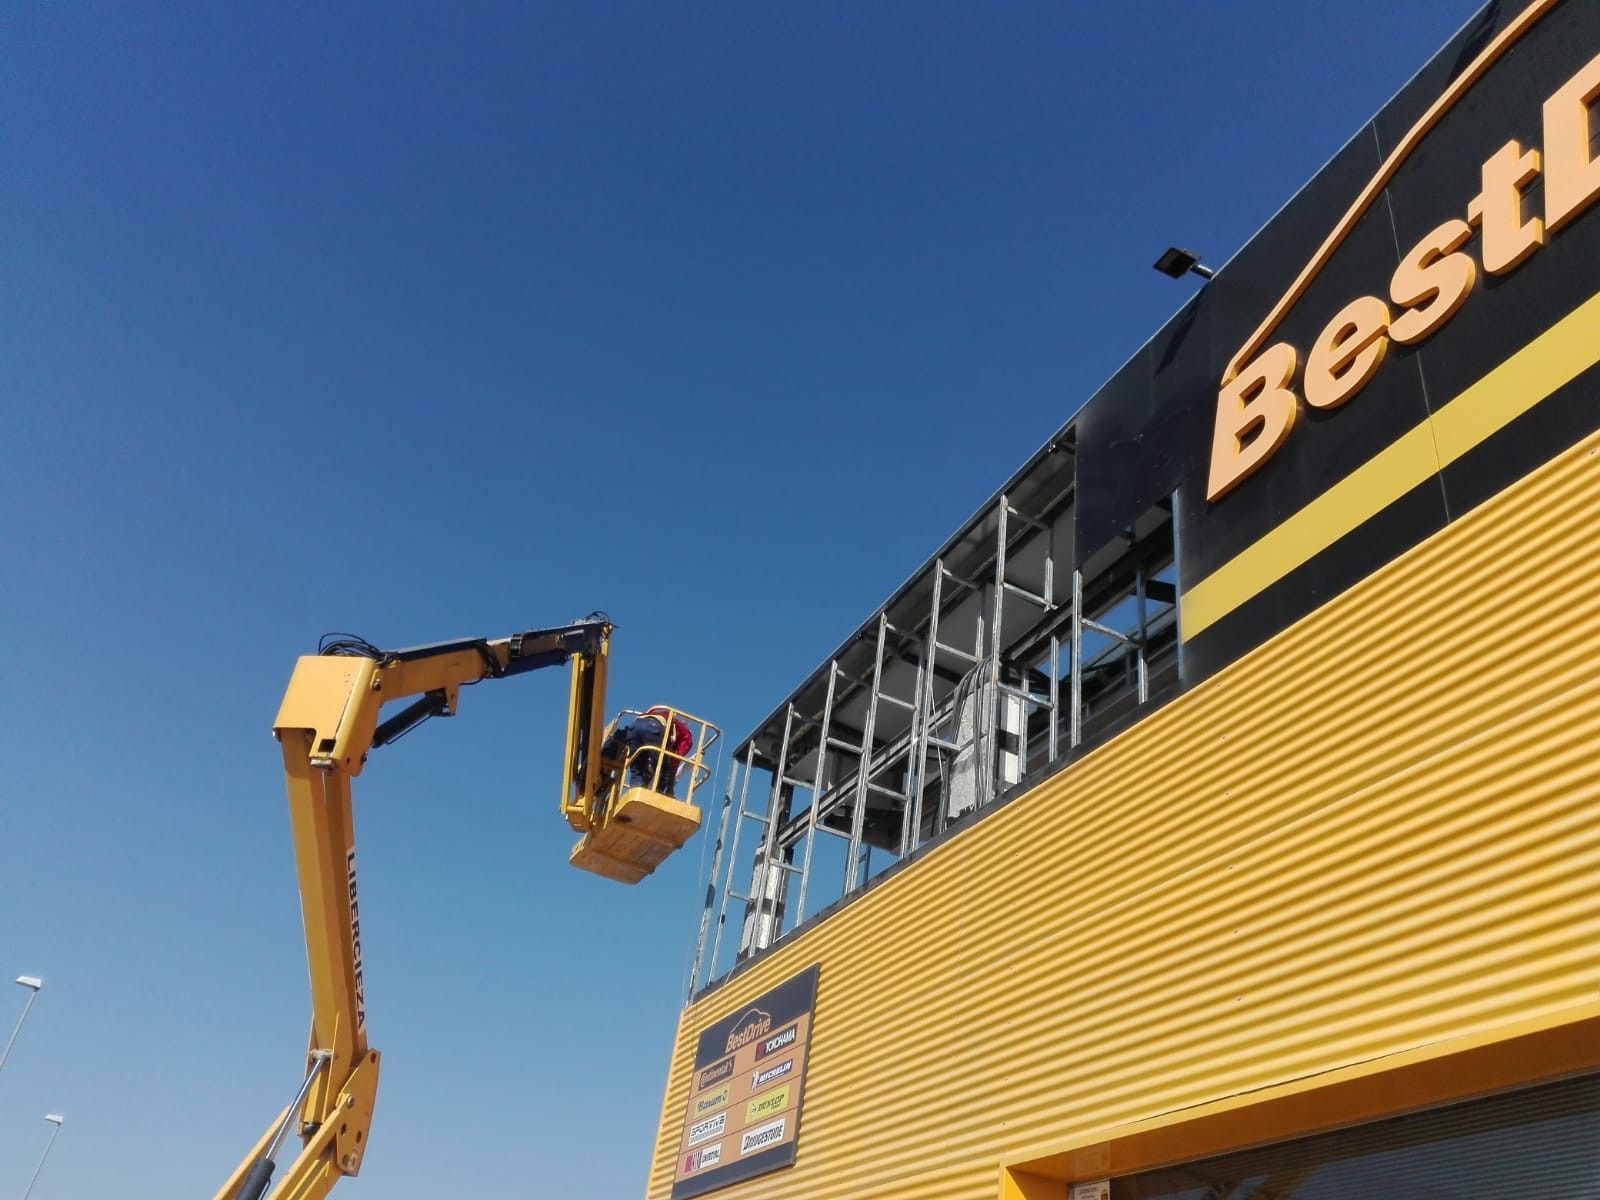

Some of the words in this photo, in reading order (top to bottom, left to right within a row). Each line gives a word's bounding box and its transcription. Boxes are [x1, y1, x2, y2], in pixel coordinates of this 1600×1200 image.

[347, 852, 365, 1029] LIBERCIEZA
[725, 1018, 771, 1053] BestDrive
[766, 1028, 795, 1053] YOKOHAMA
[759, 1061, 792, 1083] MICHELIN
[757, 1094, 785, 1112] DUNLOP
